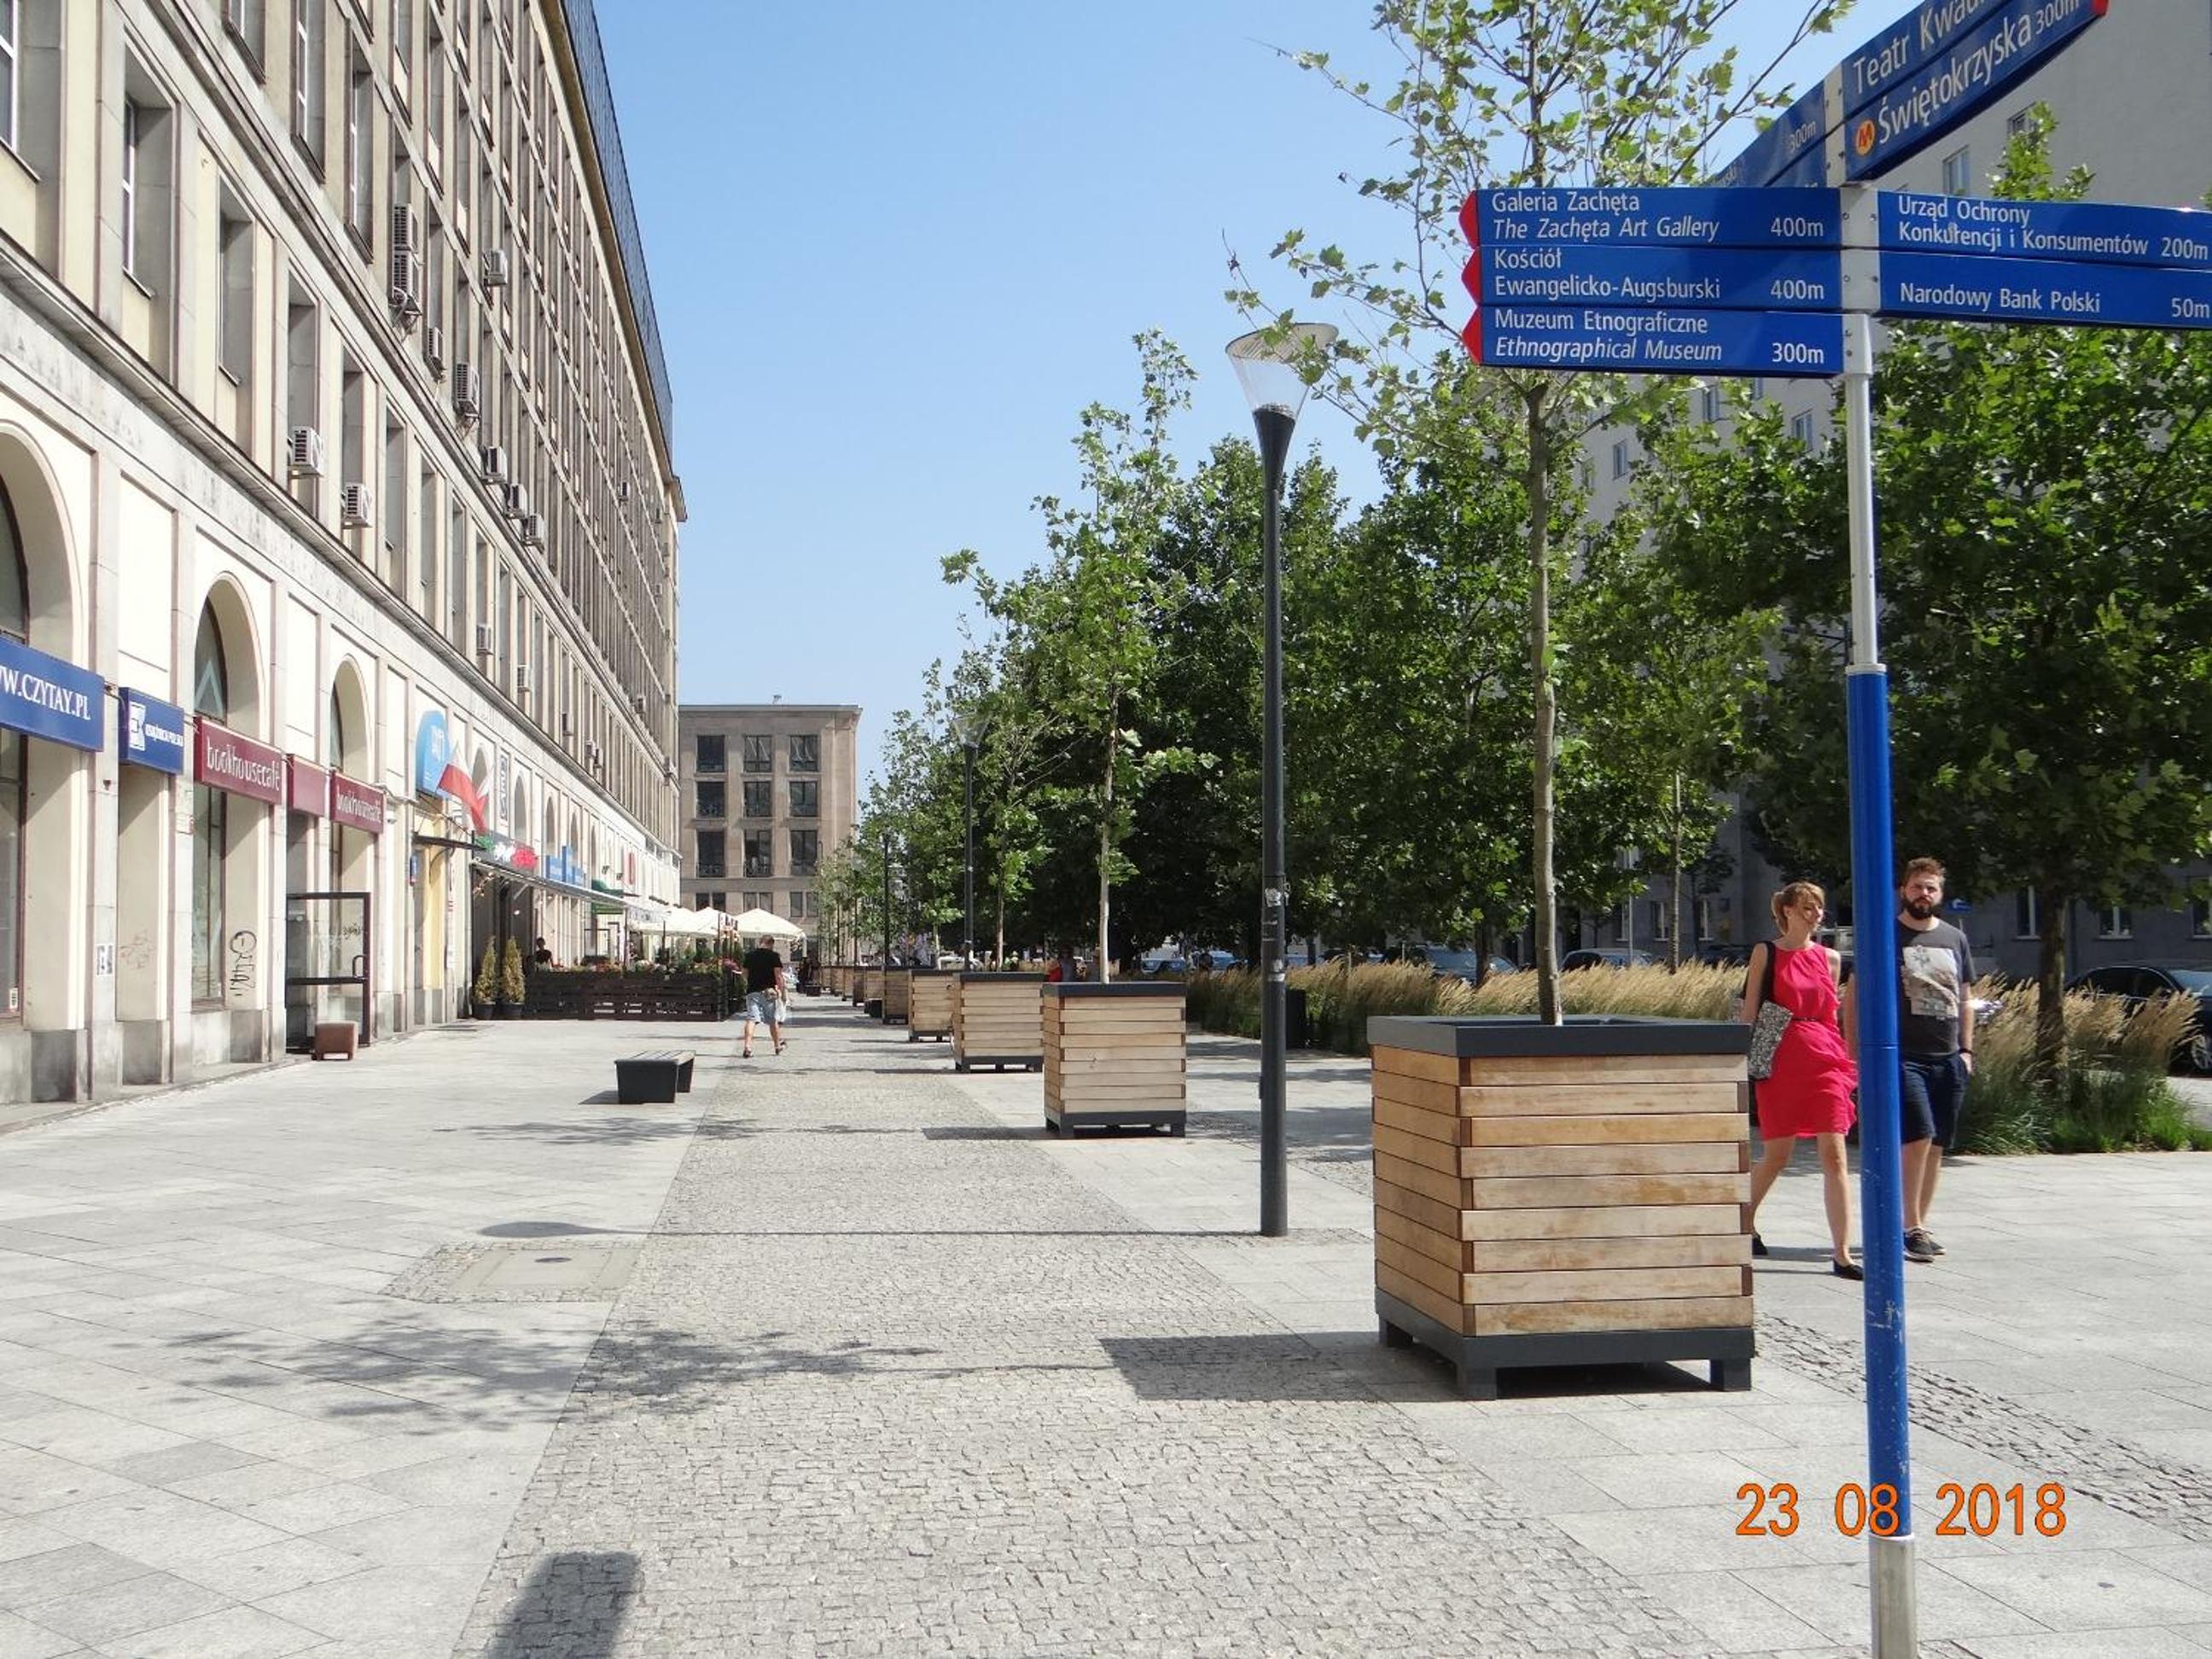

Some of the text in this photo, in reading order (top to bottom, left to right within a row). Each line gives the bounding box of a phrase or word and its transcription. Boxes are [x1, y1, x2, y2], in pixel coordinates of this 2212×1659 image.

[1853, 32, 1911, 94] Teatr
[1878, 14, 2032, 144] Świętokrzyska
[1491, 191, 1640, 216] Galeria Zachęta
[1898, 195, 2031, 228] Urząd Ochrony
[1493, 216, 1825, 242] The Zachęta Art Gallery 400m
[1899, 221, 2209, 260] Konkurencji i Konsumentów 200m
[1494, 247, 1562, 269] Kościół
[1494, 275, 1825, 300] Ewangelicko-Augsburski 400m
[1900, 282, 2210, 319] Narodowy Bank Polski 50m
[1494, 311, 1708, 336] Muzeum Etnograficzne
[1495, 337, 1825, 364] Ethnographical Museum 300m
[0, 665, 91, 721] W.CZYTAY.PL
